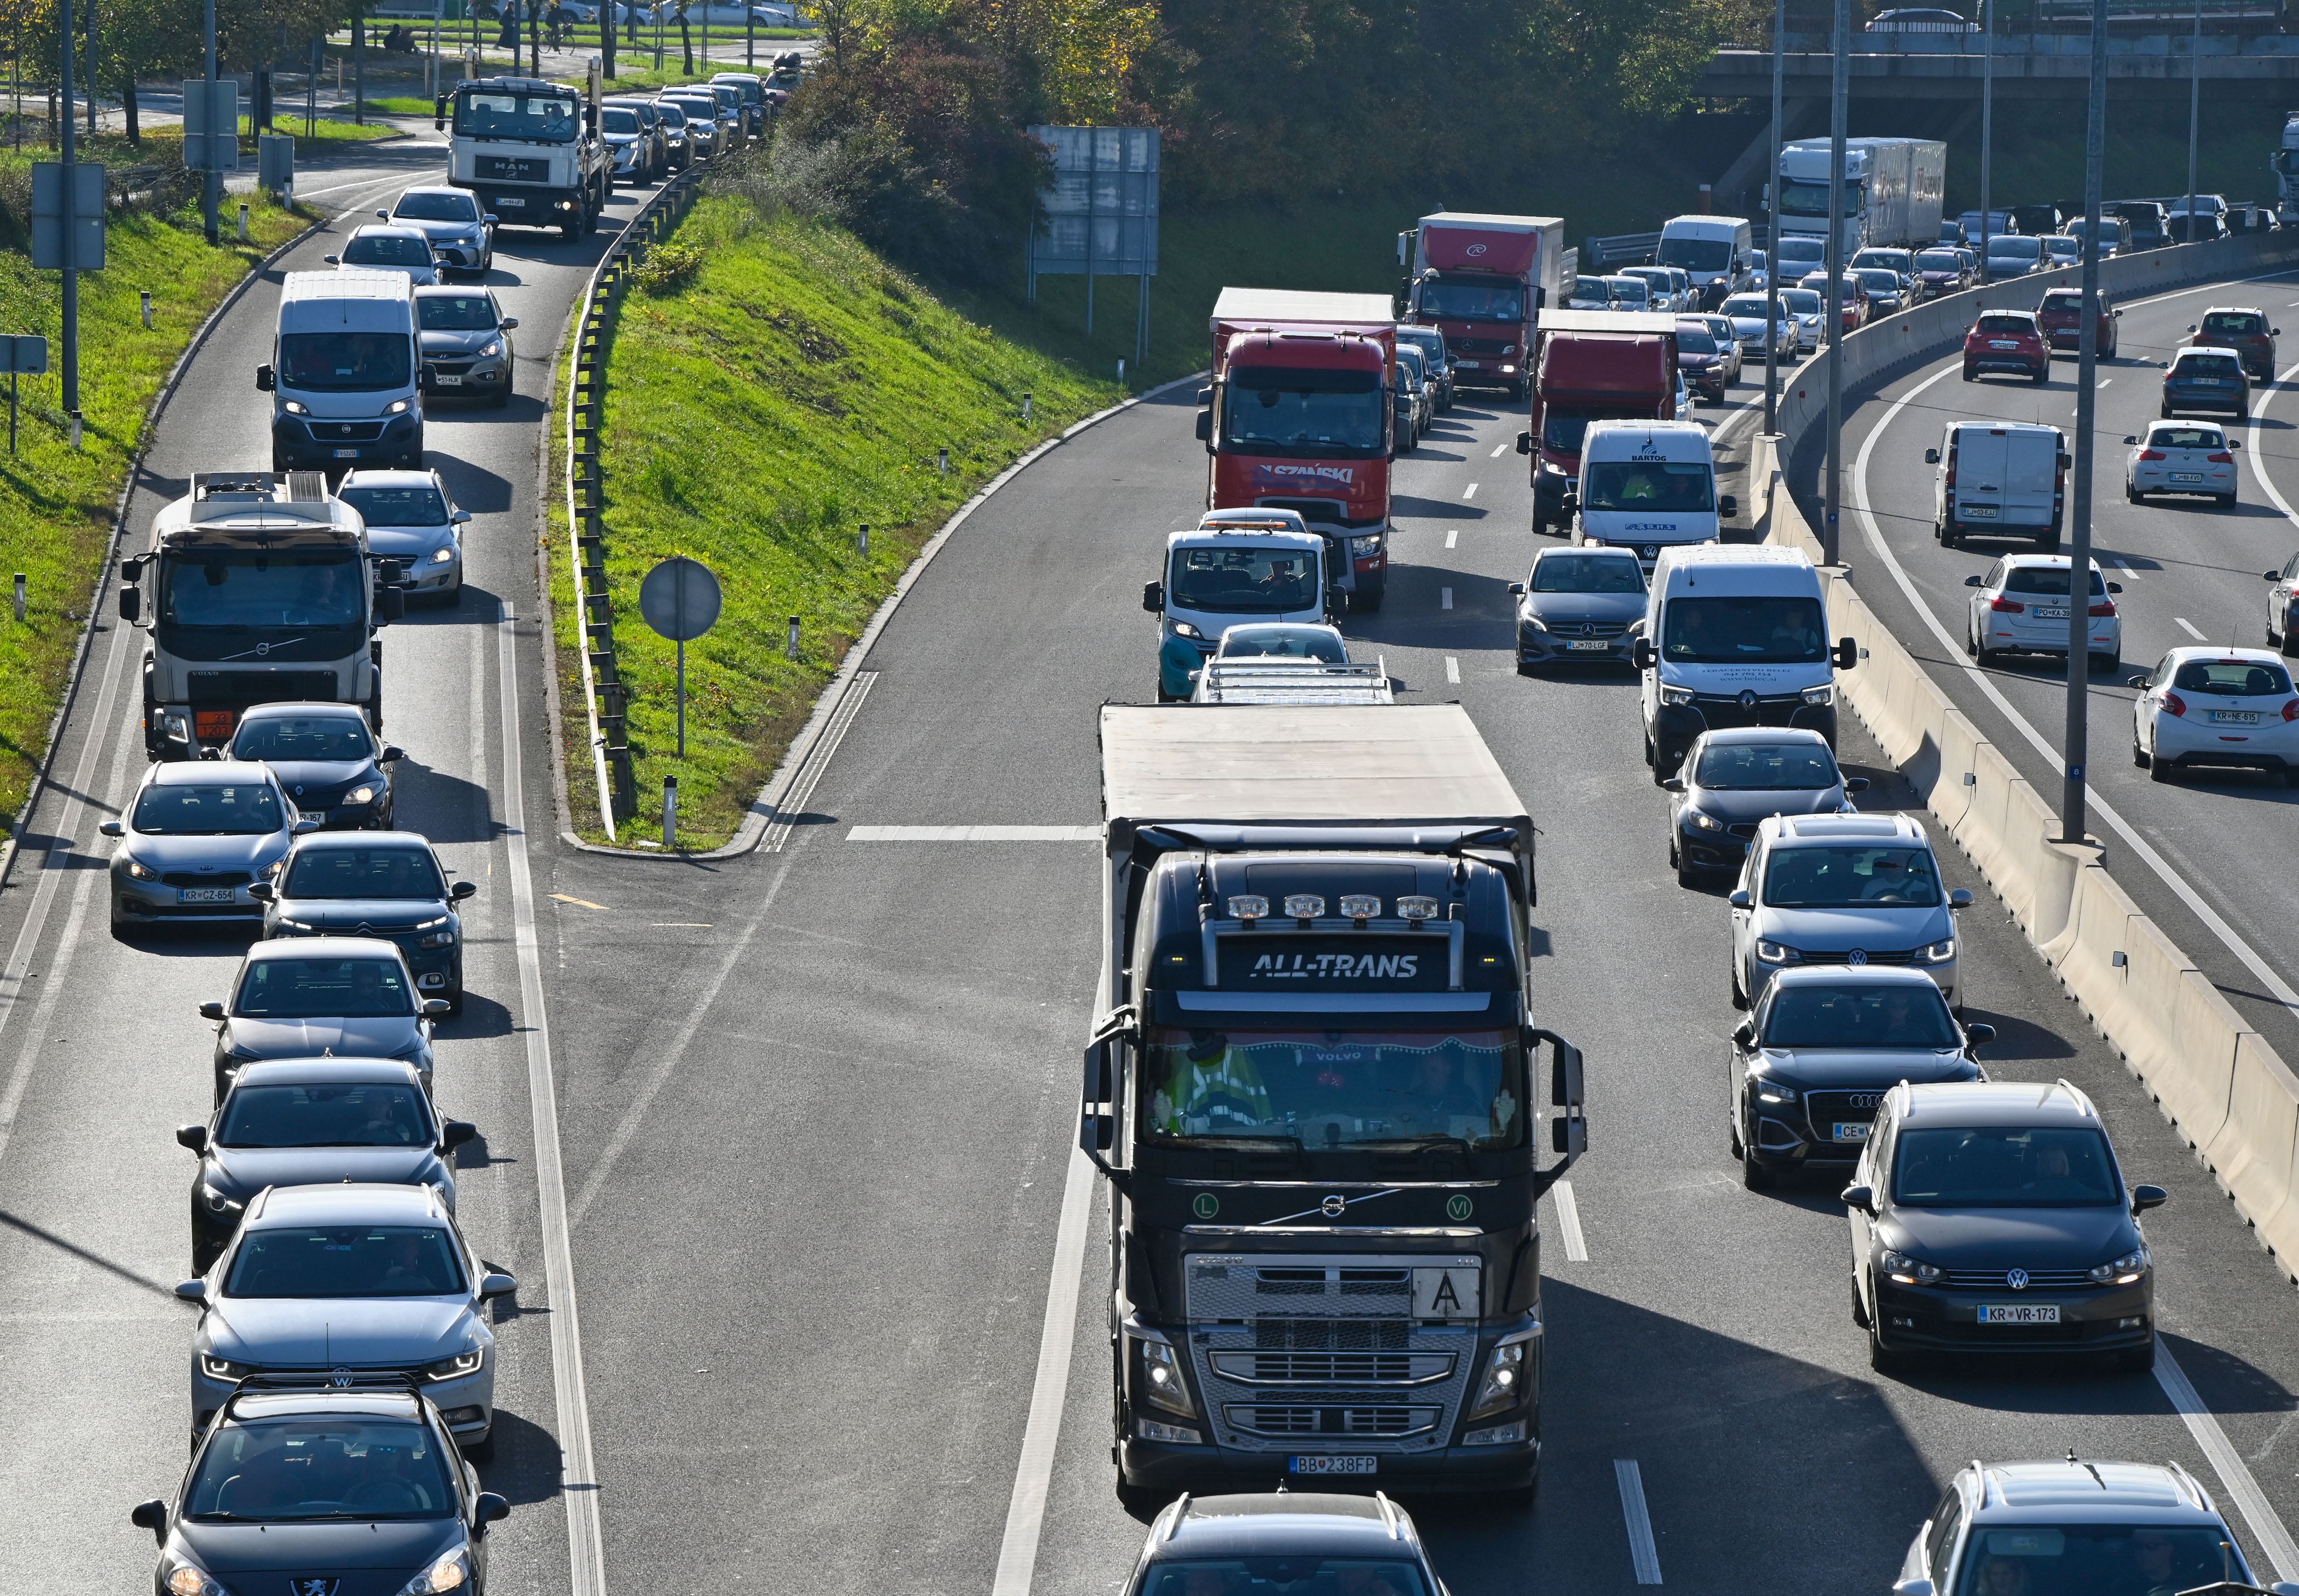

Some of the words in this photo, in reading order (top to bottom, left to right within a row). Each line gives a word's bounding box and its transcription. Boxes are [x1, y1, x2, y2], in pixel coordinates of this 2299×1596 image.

[1572, 640, 1580, 649] LJ
[1584, 641, 1606, 649] 70-LGF
[215, 714, 227, 724] 33
[203, 725, 228, 736] 1203
[186, 891, 197, 900] KR
[203, 890, 232, 900] CZ-654
[1250, 955, 1418, 978] ALL-TRANS
[1316, 1052, 1361, 1061] VOLVO
[1844, 1126, 1857, 1137] CE
[1202, 1198, 1211, 1213] L
[1452, 1201, 1466, 1215] VI
[1431, 1273, 1461, 1311] A
[1990, 1308, 2006, 1321] KR
[2015, 1308, 2056, 1321] VR-173
[1299, 1458, 1317, 1472] BB
[1327, 1458, 1374, 1472] 238FP
